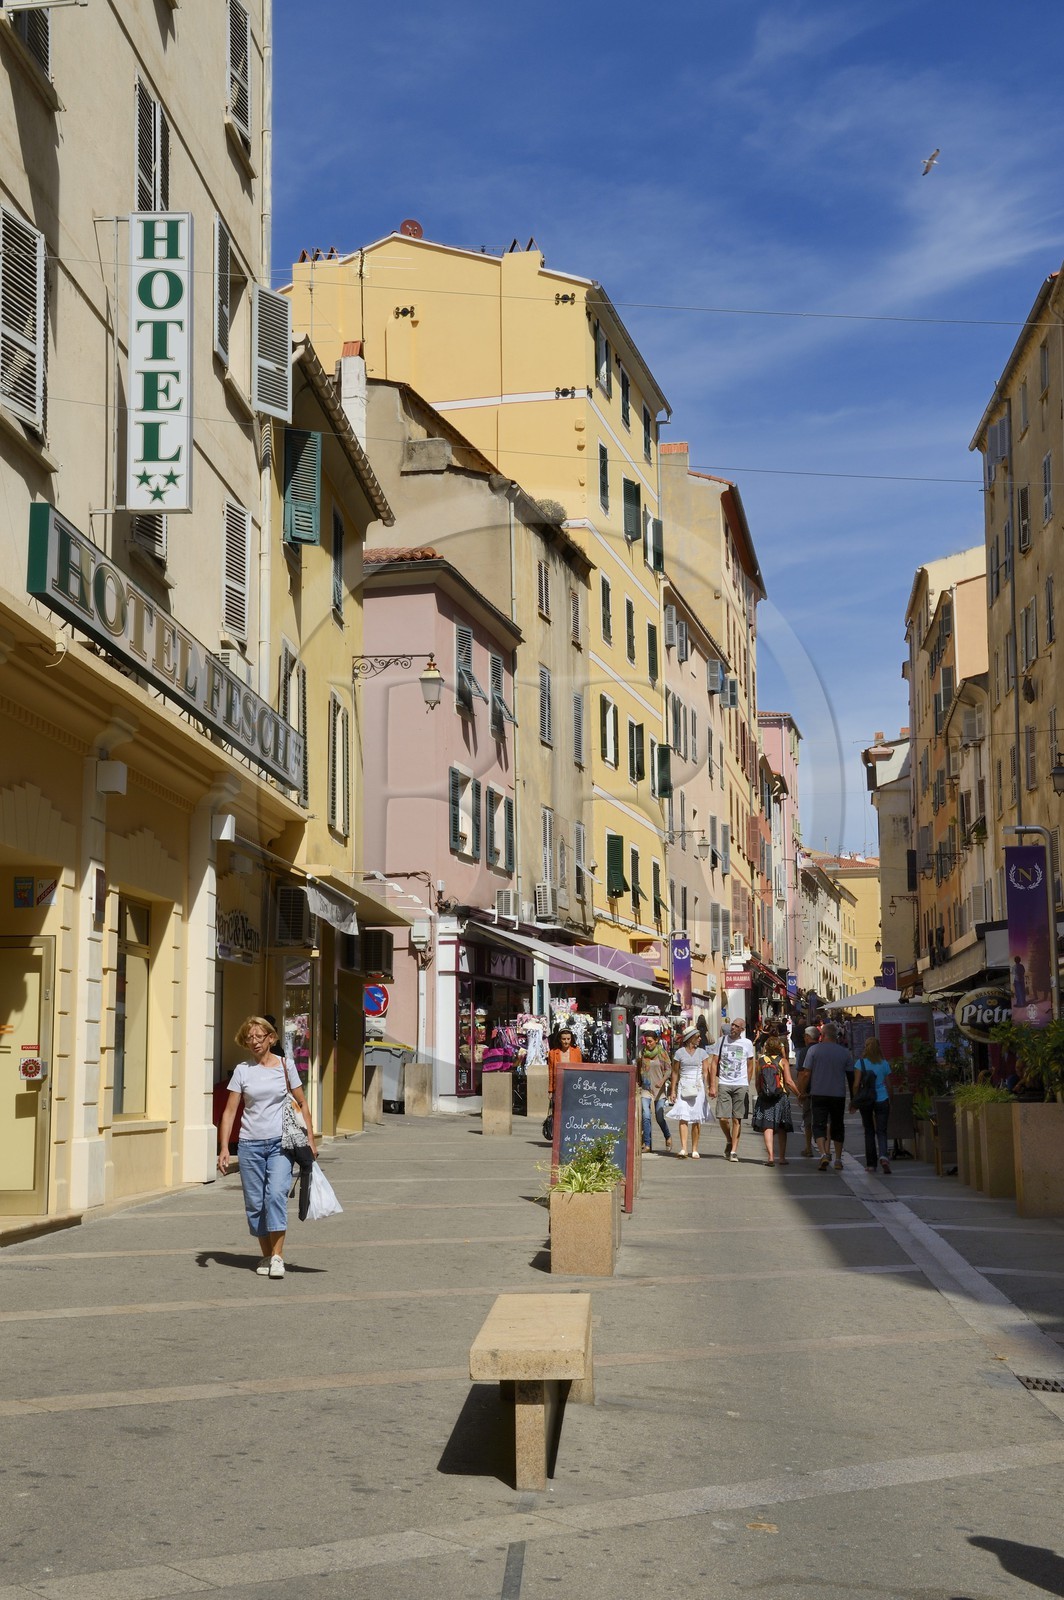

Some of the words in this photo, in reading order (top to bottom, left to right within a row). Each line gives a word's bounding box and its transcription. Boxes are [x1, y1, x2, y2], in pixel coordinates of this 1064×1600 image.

[134, 218, 186, 464] HOTEL
[51, 517, 199, 702] HOTEL
[204, 654, 291, 775] FESCH
[1017, 867, 1034, 882] N
[961, 1004, 1012, 1026] Pietr
